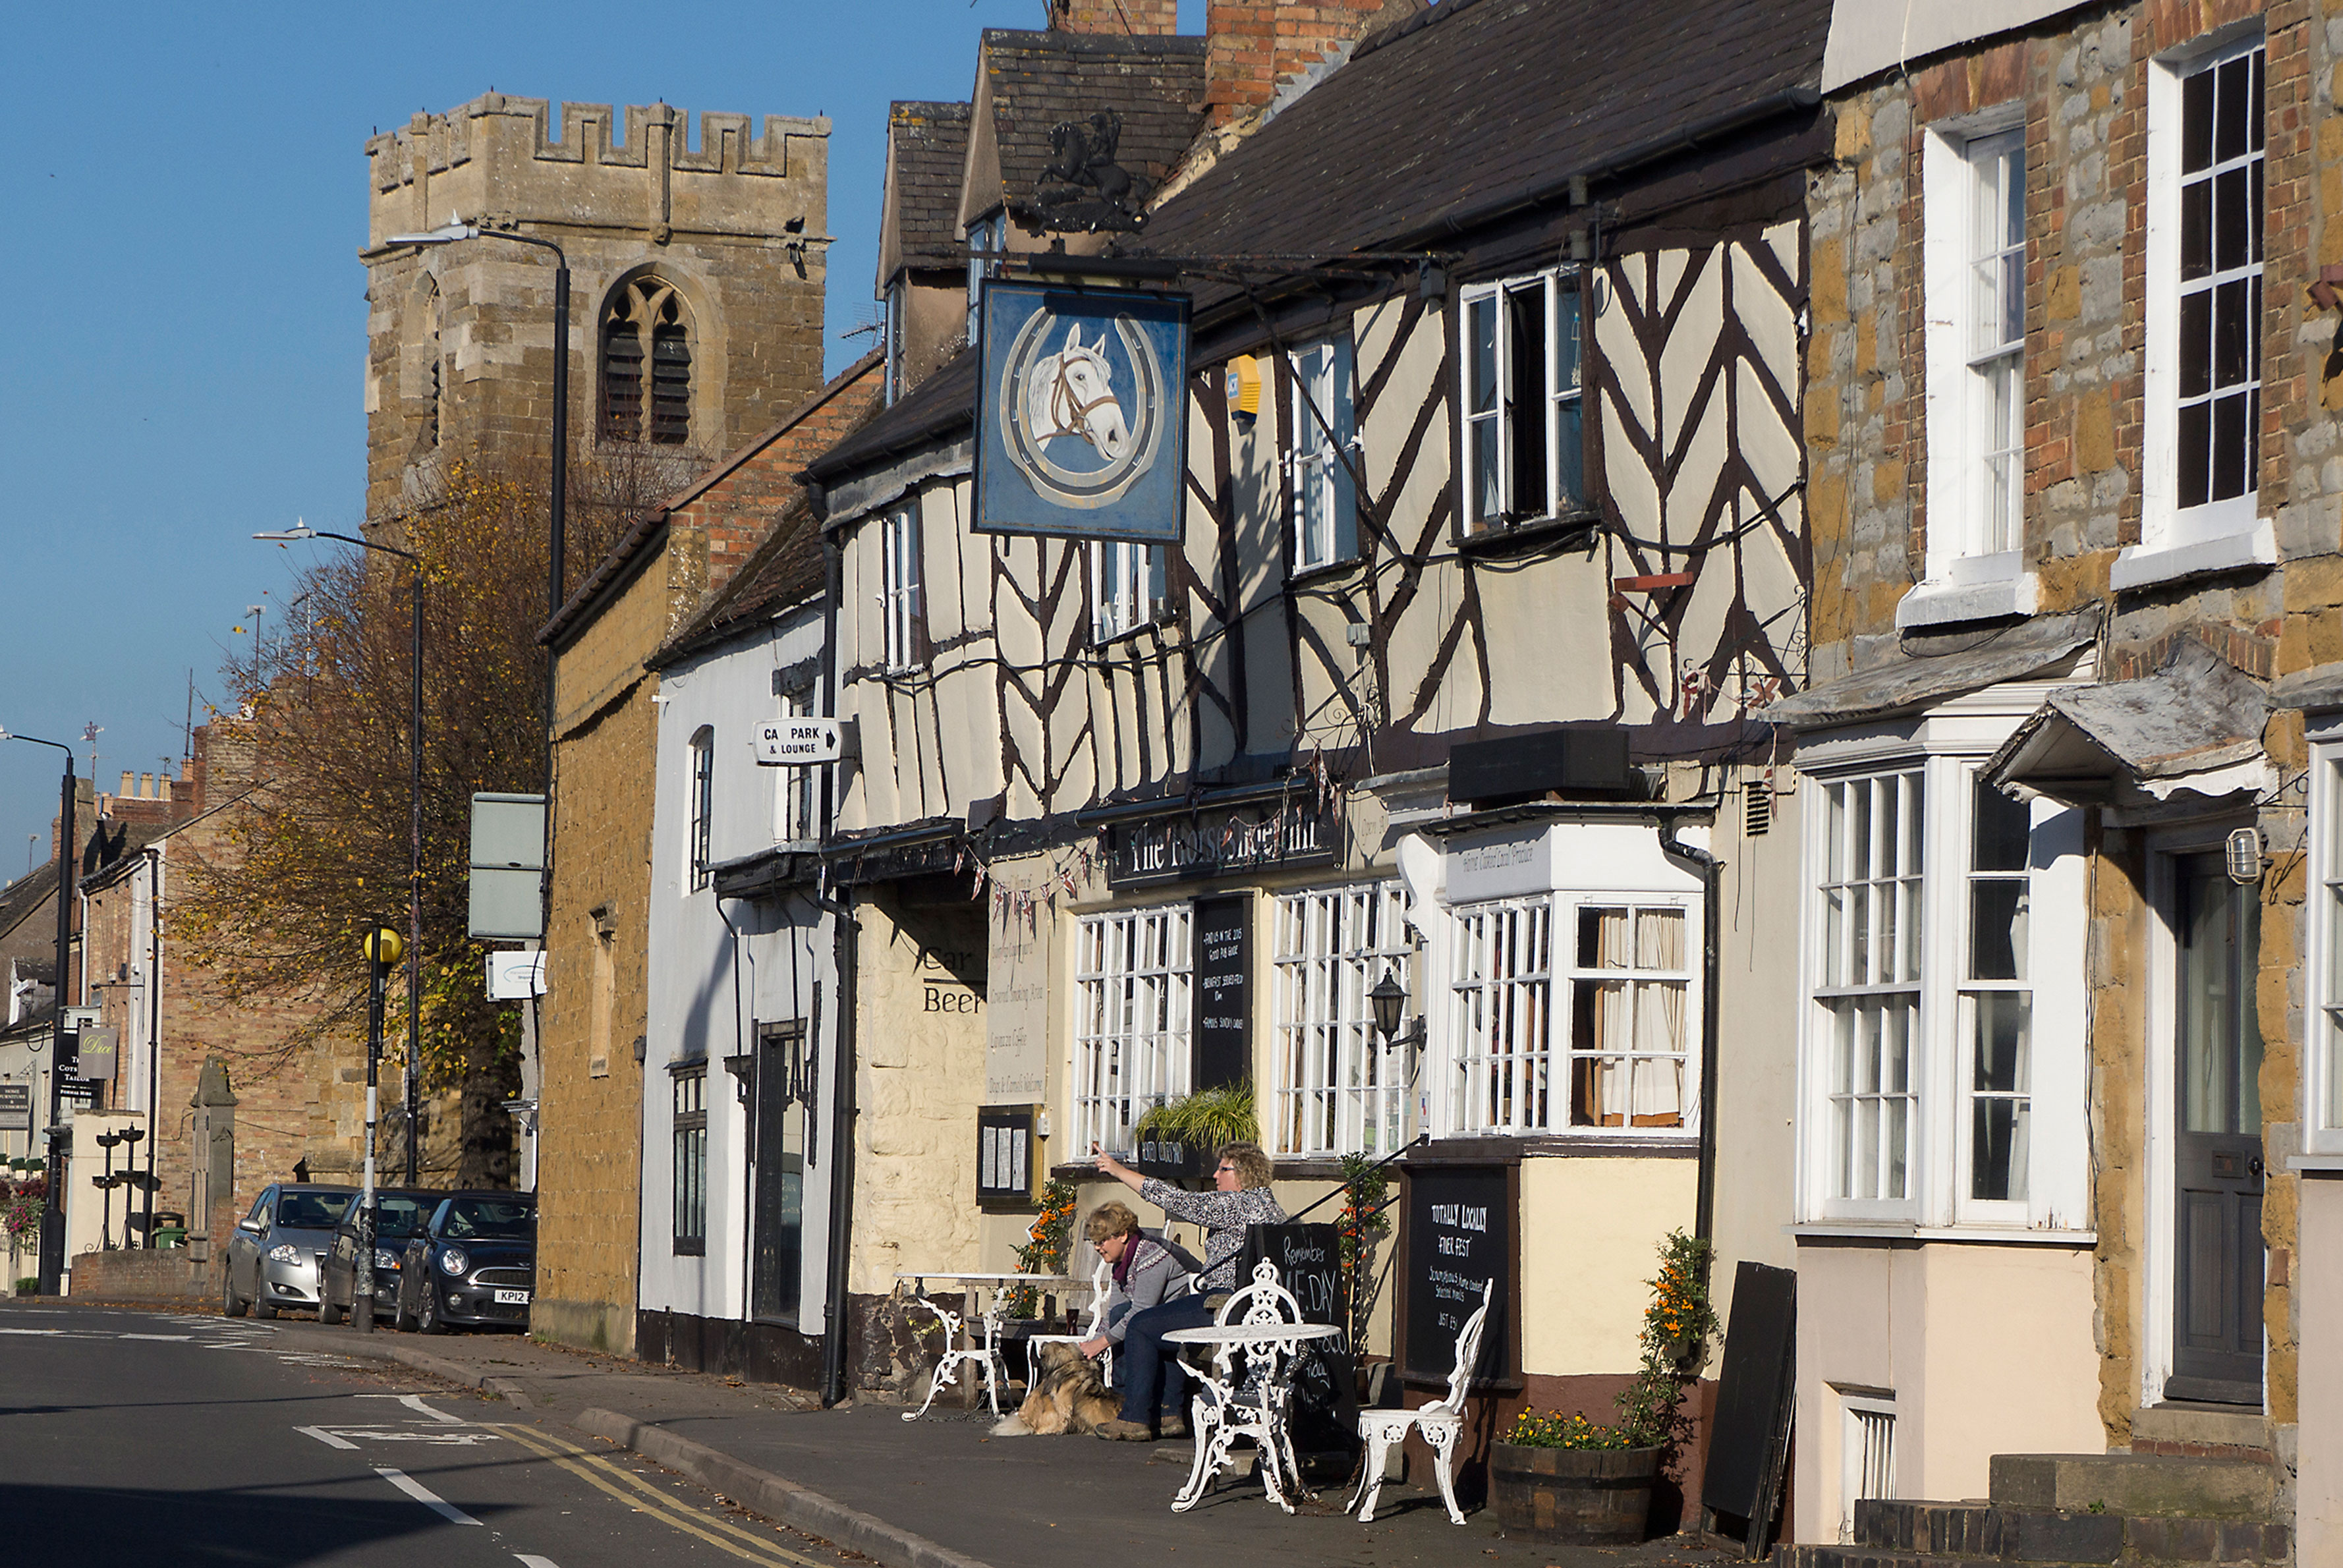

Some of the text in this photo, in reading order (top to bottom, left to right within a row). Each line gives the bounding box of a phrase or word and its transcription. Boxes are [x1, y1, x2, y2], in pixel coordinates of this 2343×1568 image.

[791, 727, 820, 739] PARK
[770, 744, 816, 754] & LOUNGE
[1131, 819, 1165, 872] The
[923, 947, 973, 972] Car
[923, 987, 984, 1014] Beer
[81, 1034, 113, 1054] Dice
[1431, 1204, 1487, 1234] TOTALLY LOCALLY
[1284, 1236, 1326, 1266] Remember
[501, 1291, 525, 1302] KP12
